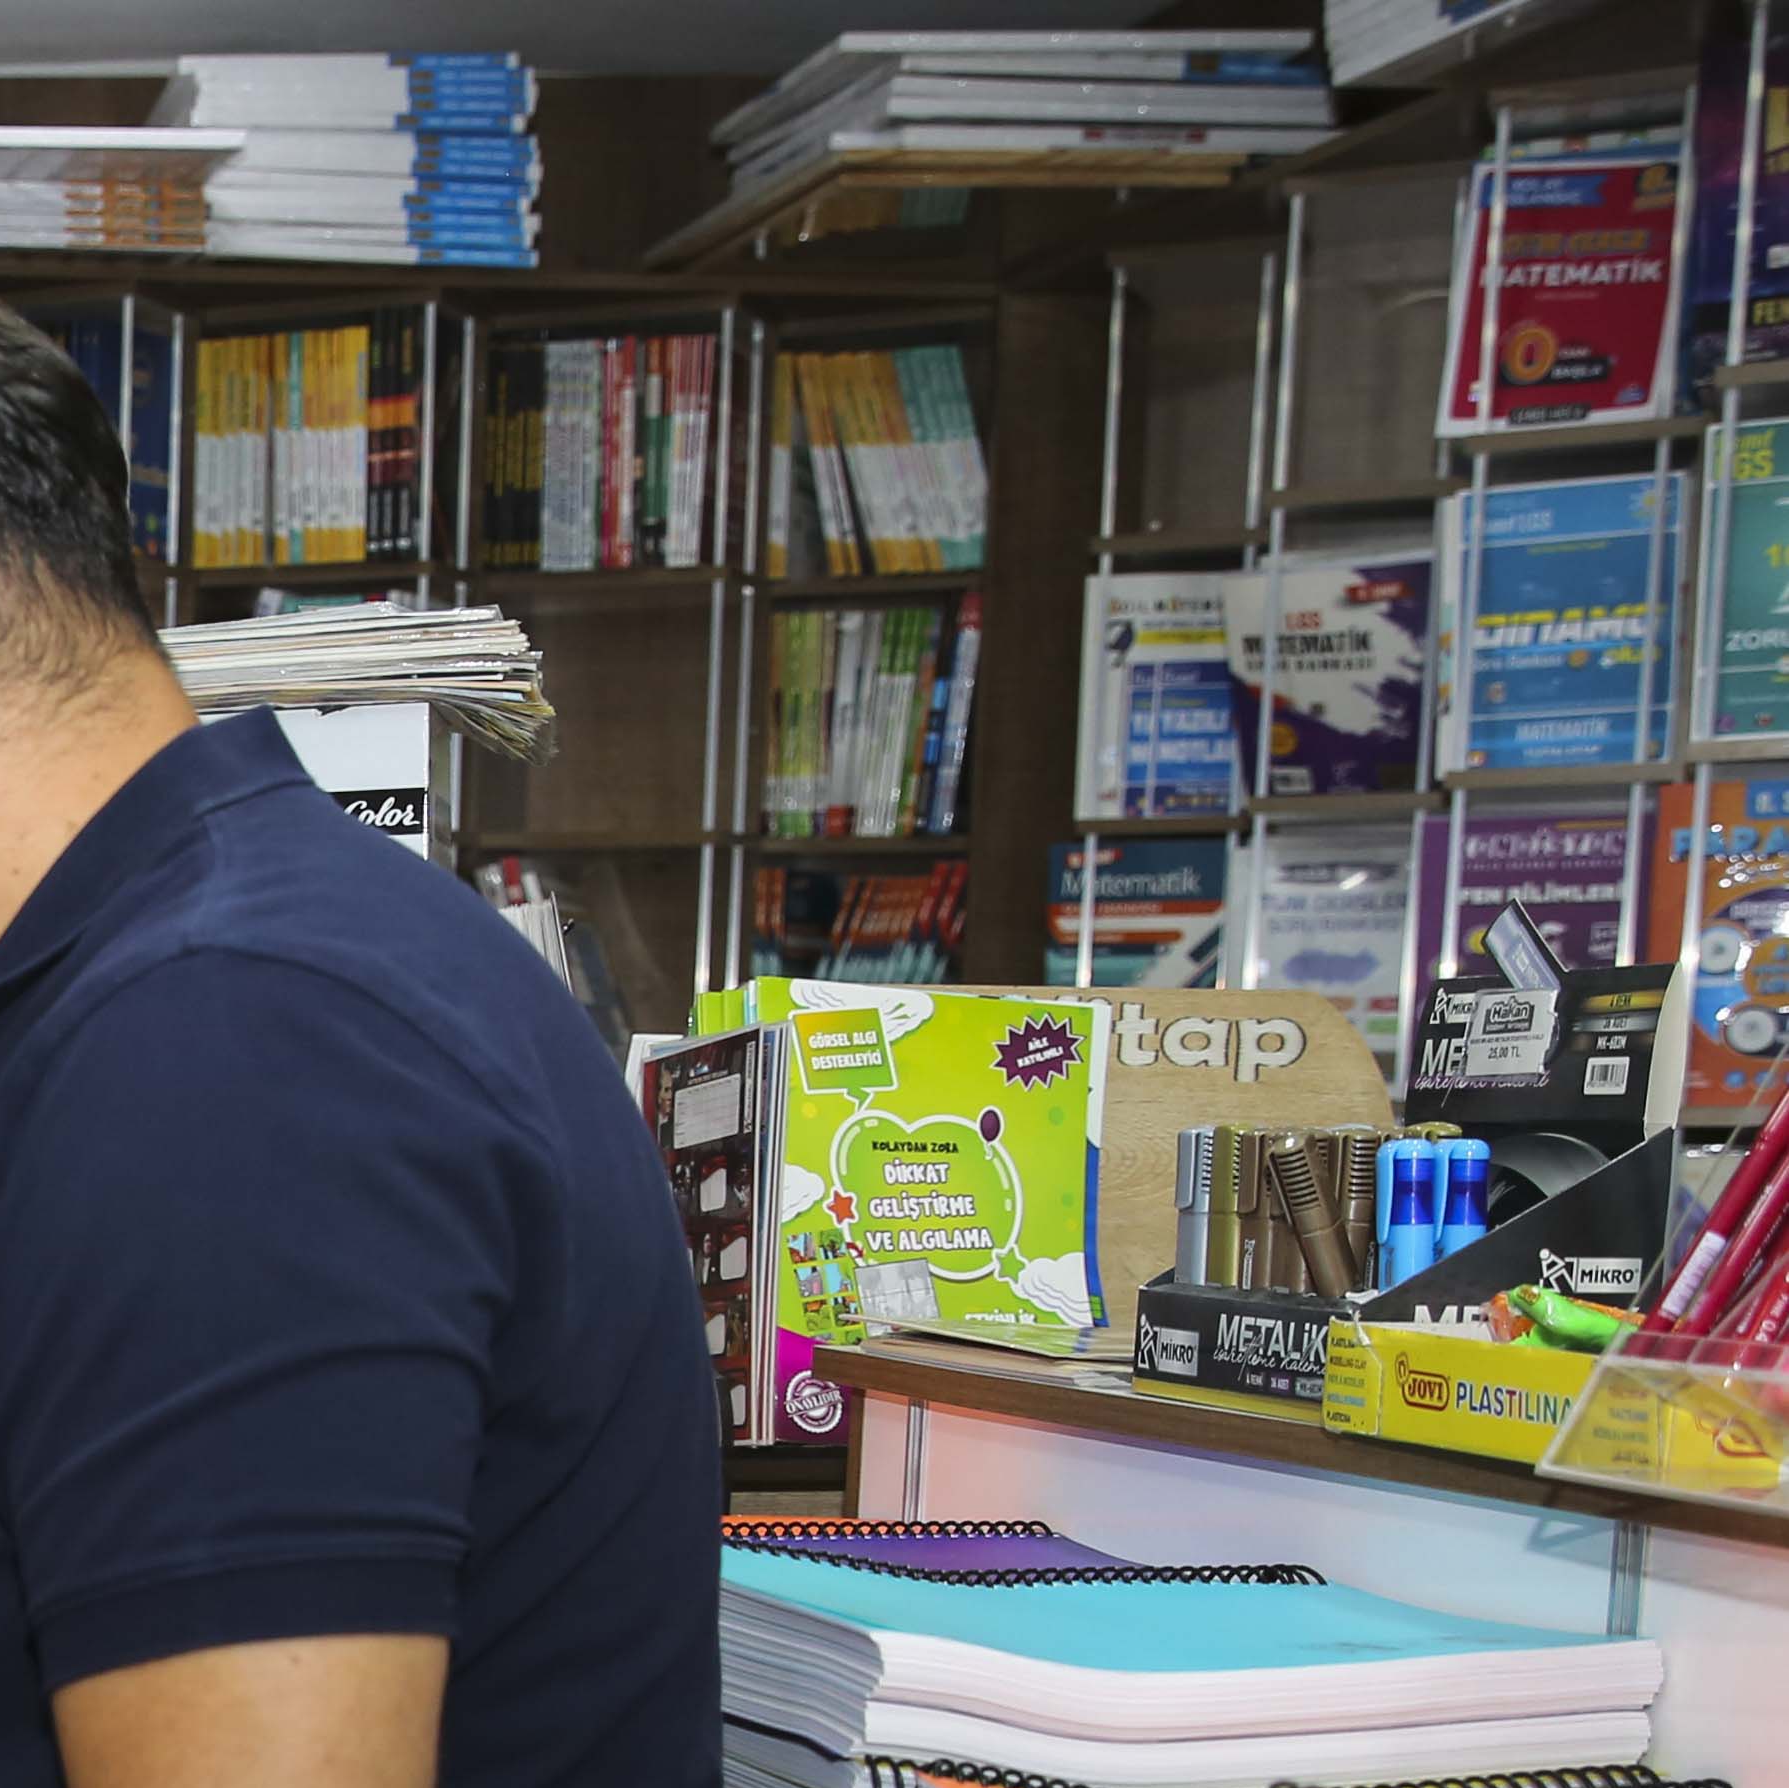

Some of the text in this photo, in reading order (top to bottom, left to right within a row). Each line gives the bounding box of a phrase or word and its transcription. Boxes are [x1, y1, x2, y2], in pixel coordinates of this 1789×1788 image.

[1060, 866, 1202, 898] Mtematik
[807, 1032, 851, 1050] GÖRSEL
[1510, 1046, 1520, 1058] TL
[810, 1049, 883, 1071] DESTEKLEYİCİ
[871, 1140, 960, 1154] KOLAYDAN ZORA
[883, 1158, 950, 1185] DİKKAT
[869, 1190, 976, 1221] GELİŞTİRME
[865, 1228, 993, 1251] VE ALGILAMA
[1579, 1266, 1635, 1285] MİKRO
[1160, 1338, 1194, 1365] MİKRO
[1407, 1376, 1445, 1401] JOVI
